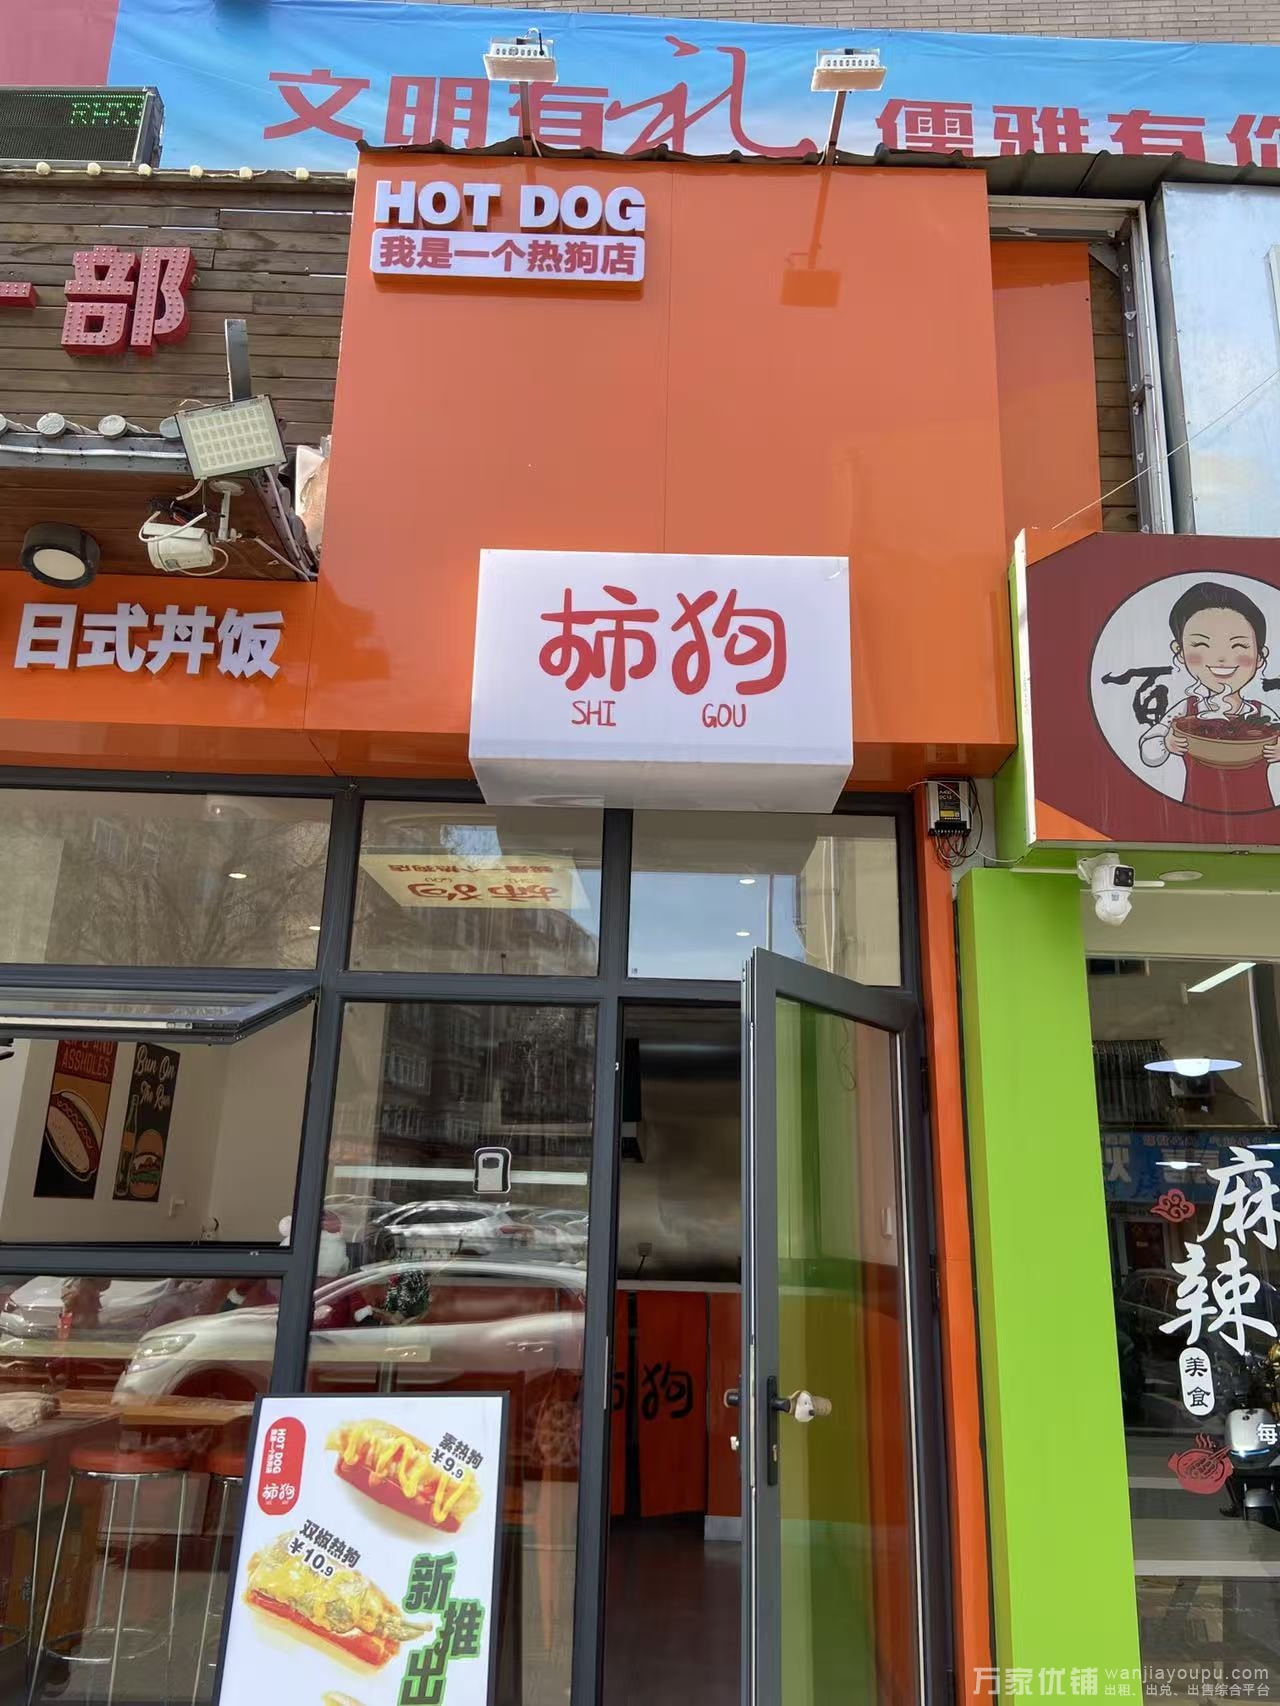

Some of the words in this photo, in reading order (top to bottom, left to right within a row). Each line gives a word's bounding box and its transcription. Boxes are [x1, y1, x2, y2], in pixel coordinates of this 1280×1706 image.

[374, 180, 502, 228] HOT
[520, 184, 646, 233] DOG
[379, 235, 637, 276] 我是一个热狗店
[14, 602, 285, 680] 日式丼饭
[539, 585, 787, 696] 柿狗
[571, 700, 617, 727] SHI
[702, 703, 747, 728] GOU
[62, 1049, 111, 1078] ASSHOLES
[135, 1044, 157, 1076] Bun
[159, 1055, 176, 1082] On
[1158, 1146, 1280, 1356] 麻辣
[1184, 1356, 1211, 1408] 美食
[276, 1428, 287, 1449] HOT
[1257, 1423, 1280, 1445] 每
[262, 1483, 295, 1500] 柿狗
[289, 1536, 335, 1578] ¥10.9
[299, 1518, 363, 1569] 双椒热狗
[400, 1552, 486, 1706] 新推出
